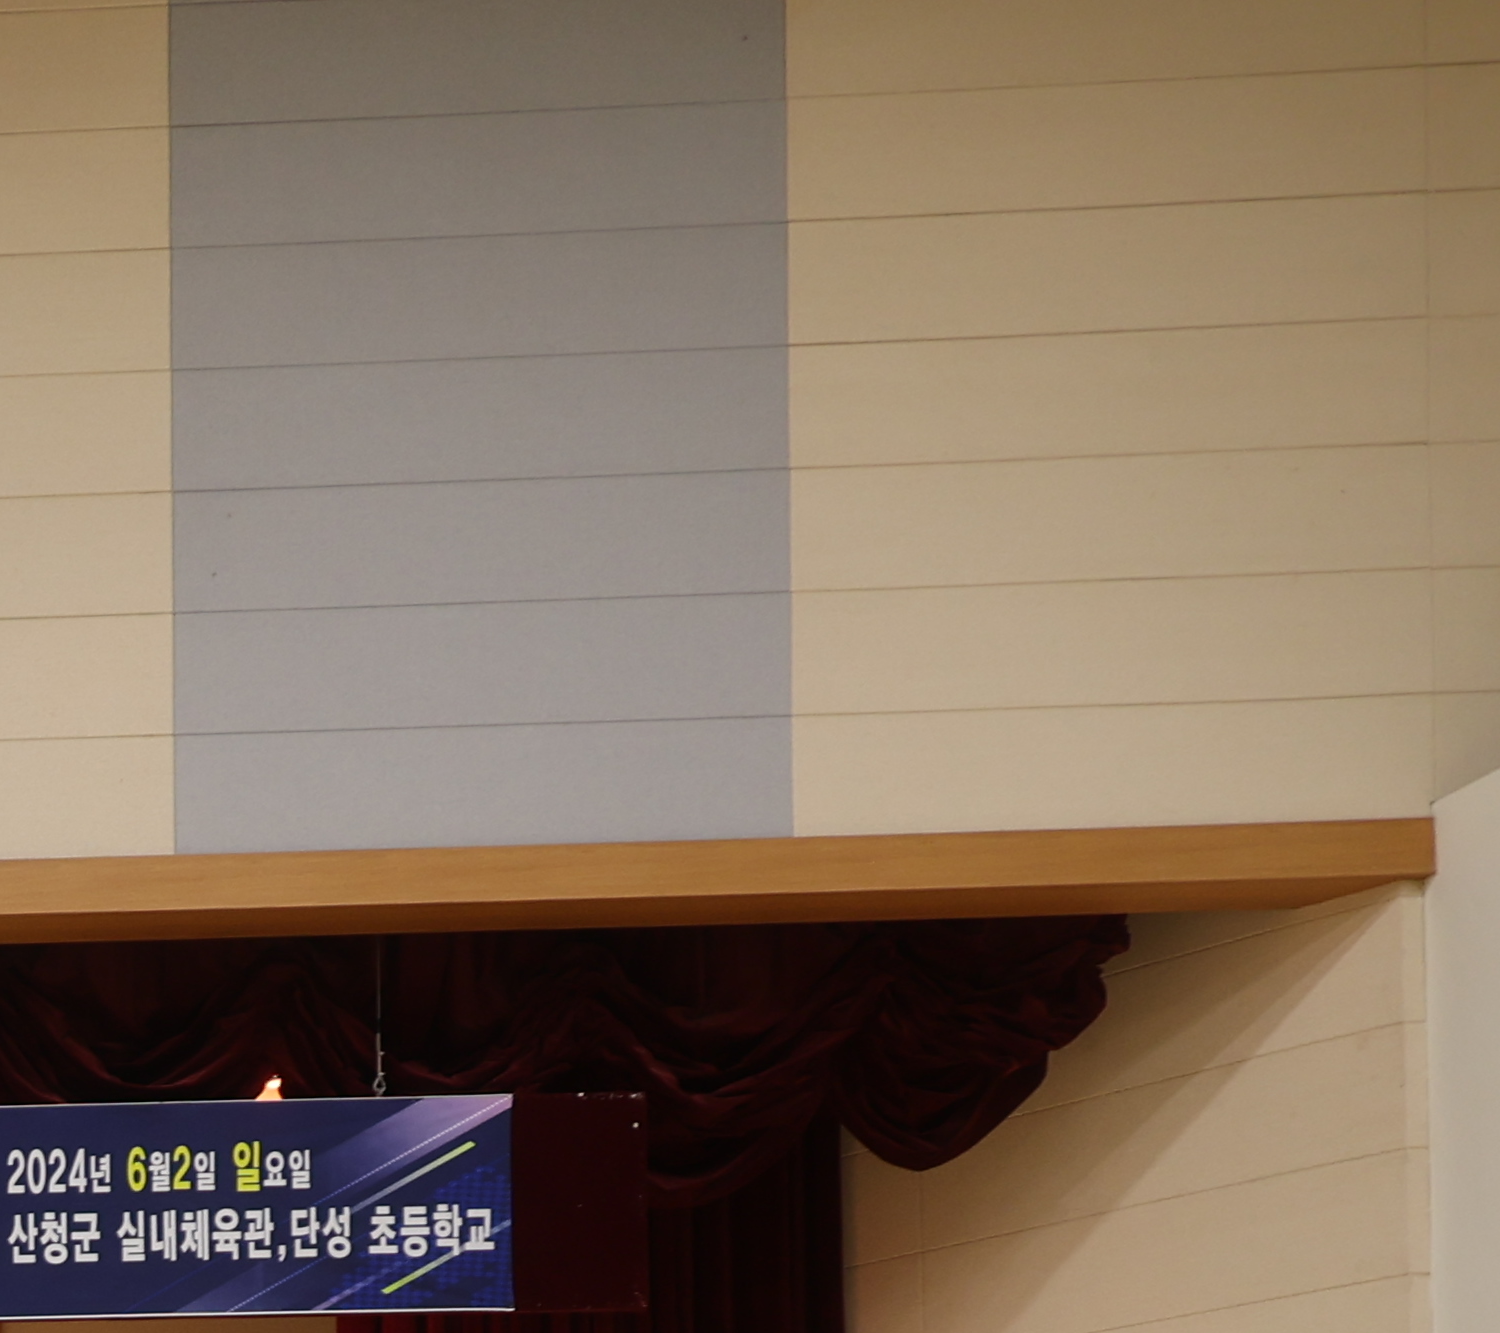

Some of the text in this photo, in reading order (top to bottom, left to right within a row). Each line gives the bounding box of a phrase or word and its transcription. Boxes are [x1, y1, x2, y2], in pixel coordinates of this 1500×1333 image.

[7, 1148, 111, 1195] 2024년
[127, 1145, 216, 1193] 6월2일
[233, 1141, 311, 1193] 일요일
[7, 1212, 101, 1266] 산청군
[368, 1203, 495, 1259] 초등학교
